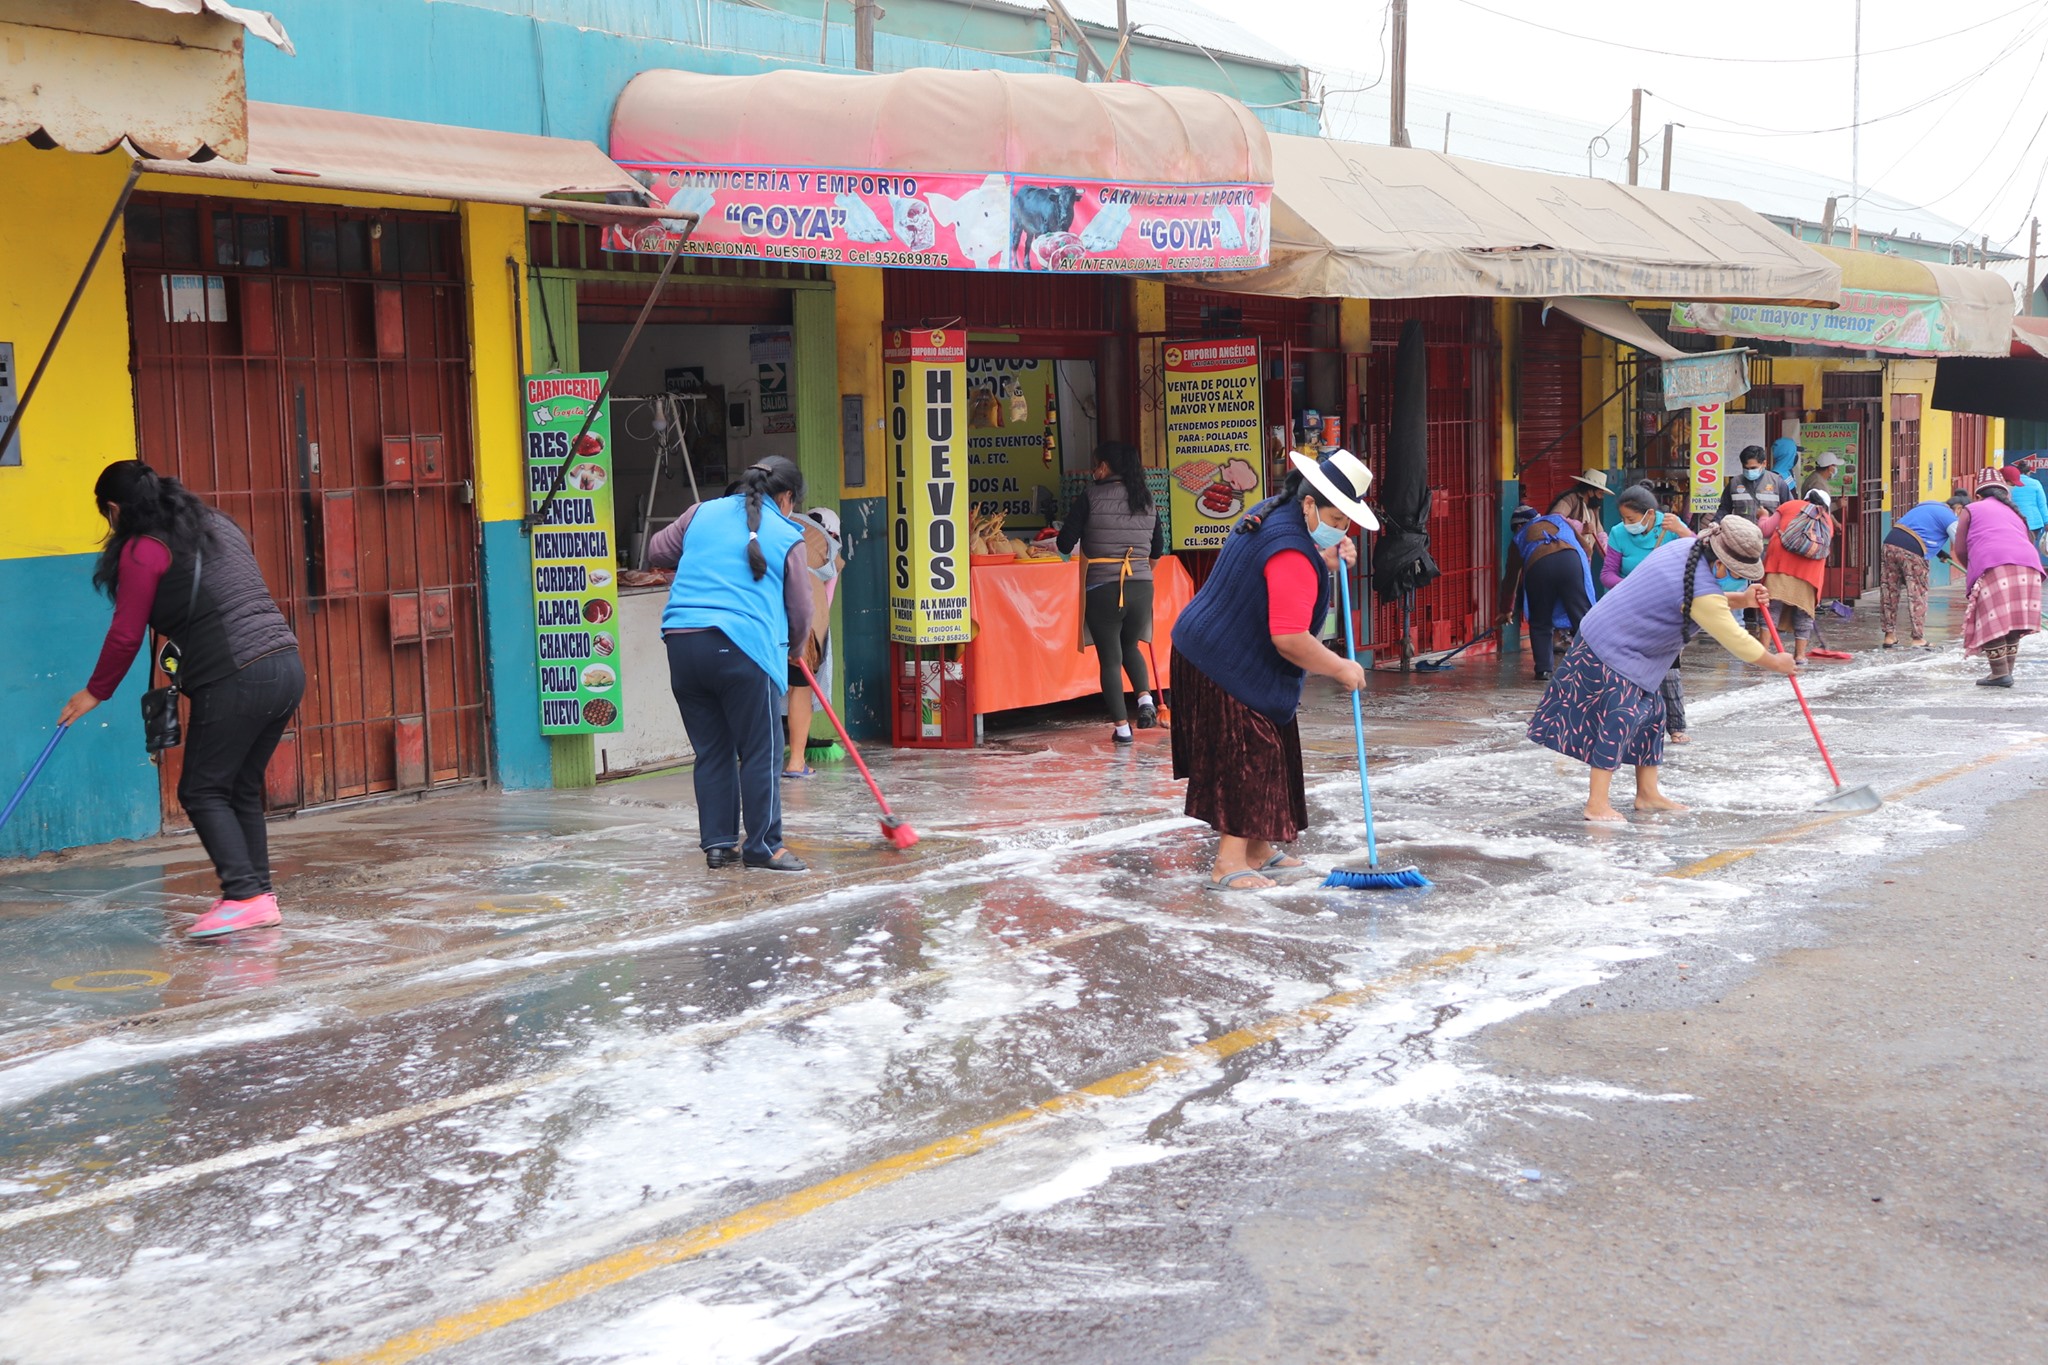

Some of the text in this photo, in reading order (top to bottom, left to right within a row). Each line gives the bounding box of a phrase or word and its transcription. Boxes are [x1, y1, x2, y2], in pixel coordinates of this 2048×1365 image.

[668, 169, 917, 196] CARNICERÍA Y EMPORIO
[1191, 191, 1199, 205] Y
[1202, 190, 1255, 206] EMPORIO
[766, 245, 817, 260] PUESTO
[820, 249, 842, 261] #32
[849, 250, 949, 266] Cel:952689875
[1060, 258, 1077, 269] AV.
[1080, 257, 1162, 270] INTERNACIONAL
[1166, 257, 1201, 269] PUESTO
[1840, 292, 1911, 318] OLLOS
[1730, 305, 1877, 332] por mayor y menor
[912, 347, 936, 356] EMPORIO
[1183, 345, 1256, 361] EMPORIO ANGÉLICA
[966, 357, 1039, 373] UEVOS
[527, 378, 602, 404] CARNICERIA
[667, 378, 697, 391] SALIDA
[966, 375, 1013, 399] NOR
[1168, 377, 1256, 392] VENTA DE POLLO Y
[762, 395, 788, 410] SALIDA
[1181, 390, 1243, 403] HUEVOS AL X
[1170, 400, 1255, 415] MAYOR Y MENOR
[1168, 419, 1257, 432] ATENDEMOS PEDIDOS
[529, 431, 569, 458] RES
[967, 437, 993, 448] NTOS
[1178, 434, 1200, 443] PARA
[1206, 431, 1248, 441] POLLADAS
[1695, 404, 1720, 483] LLOS
[1176, 443, 1252, 455] PARRILLADAS, ETC.
[967, 454, 980, 465] NA
[988, 453, 1009, 464] ETC.
[2026, 459, 2048, 469] NTRA
[530, 465, 567, 492] PATA
[892, 369, 909, 590] POLLOS
[926, 370, 955, 591] HUEVOS
[969, 477, 1020, 493] DOS AL
[532, 498, 595, 526] LENGUA
[1194, 525, 1231, 535] PEDIDOS
[534, 531, 608, 559] MENUDENCIA
[536, 565, 587, 593] CORDERO
[920, 597, 967, 610] AL X MAYOR
[538, 599, 581, 626] ALPACA
[926, 609, 962, 620] Y MENOR
[539, 632, 591, 659] CHANCHO
[541, 666, 578, 692] POLLO
[543, 699, 580, 725] HUEVO
